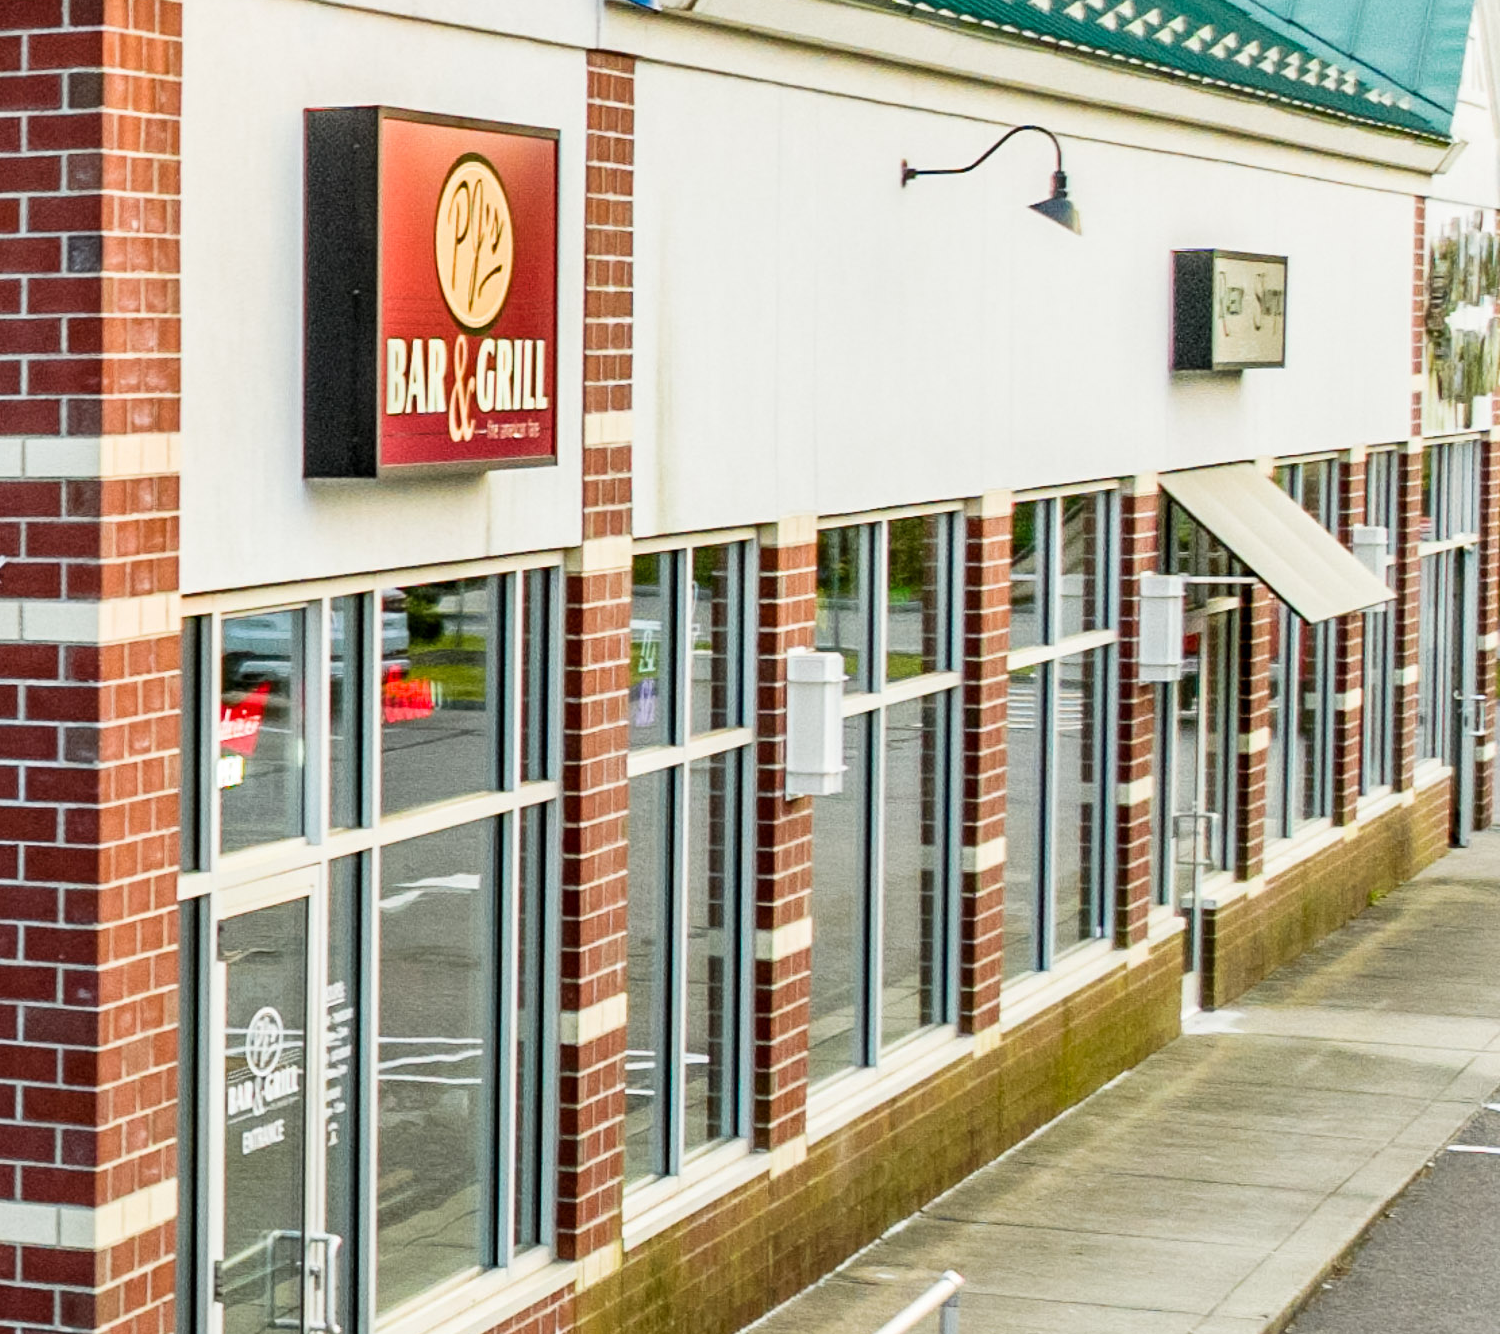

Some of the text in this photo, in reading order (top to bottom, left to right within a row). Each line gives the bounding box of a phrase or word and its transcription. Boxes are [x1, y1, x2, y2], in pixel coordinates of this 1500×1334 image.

[385, 333, 550, 443] BAR & GRILL
